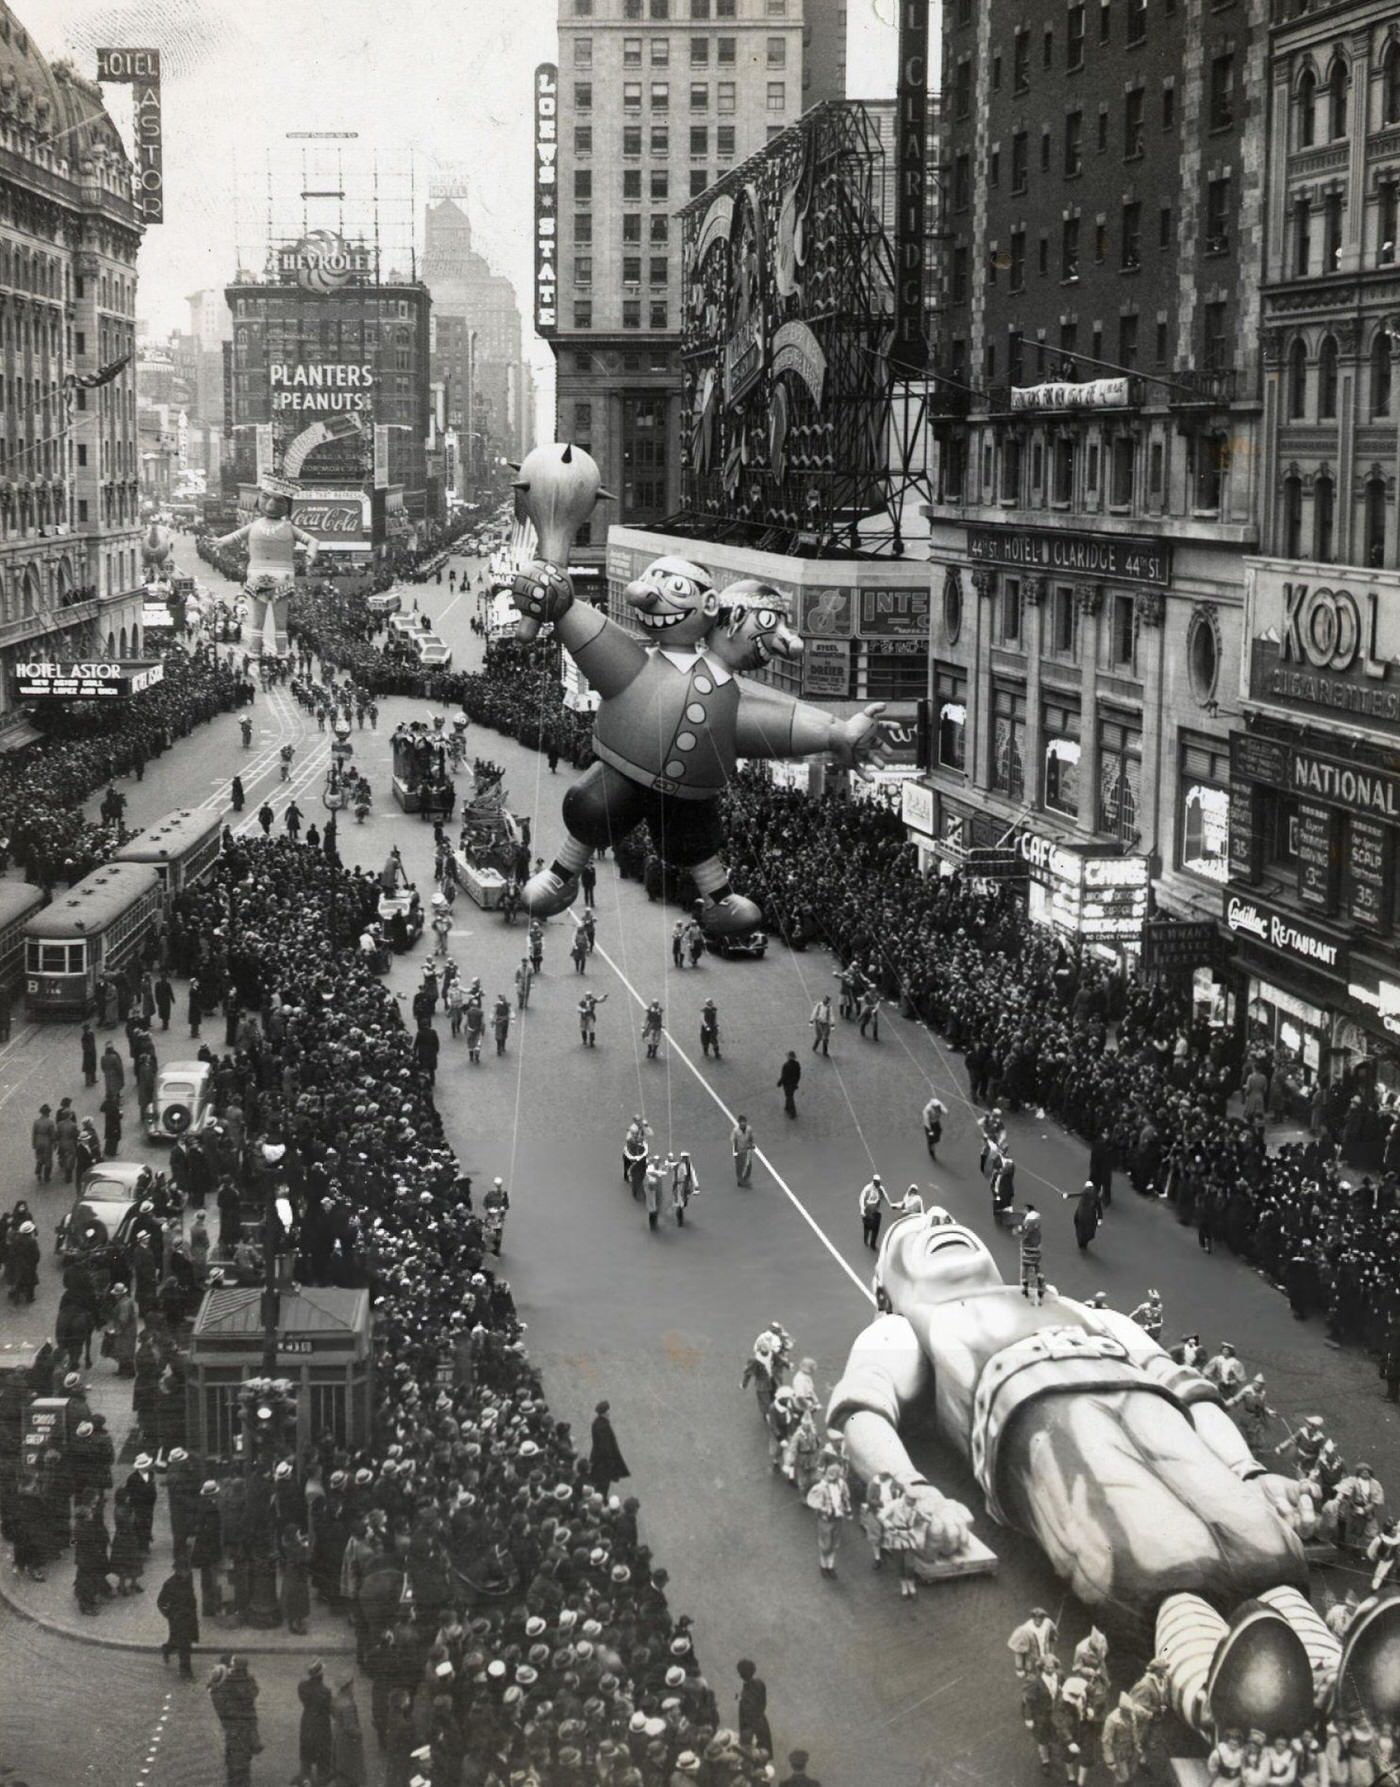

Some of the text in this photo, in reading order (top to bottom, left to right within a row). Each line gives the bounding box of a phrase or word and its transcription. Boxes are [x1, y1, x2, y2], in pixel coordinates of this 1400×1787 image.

[98, 53, 158, 76] HOTEL
[140, 88, 162, 217] ASTOR
[904, 55, 923, 343] CLARIDGE
[538, 217, 556, 325] STATE
[270, 364, 373, 386] PLANTERS
[280, 392, 364, 410] PEANUTS
[1053, 540, 1116, 571] CLARIDGE
[1279, 581, 1391, 680] KOOL
[16, 663, 121, 679] HOTEL ASTOR
[1272, 668, 1397, 721] CIGARETTES
[1295, 756, 1399, 816] NATIONAL
[1351, 847, 1382, 869] SCALP
[1228, 897, 1337, 966] Cadillac RESTAURANT
